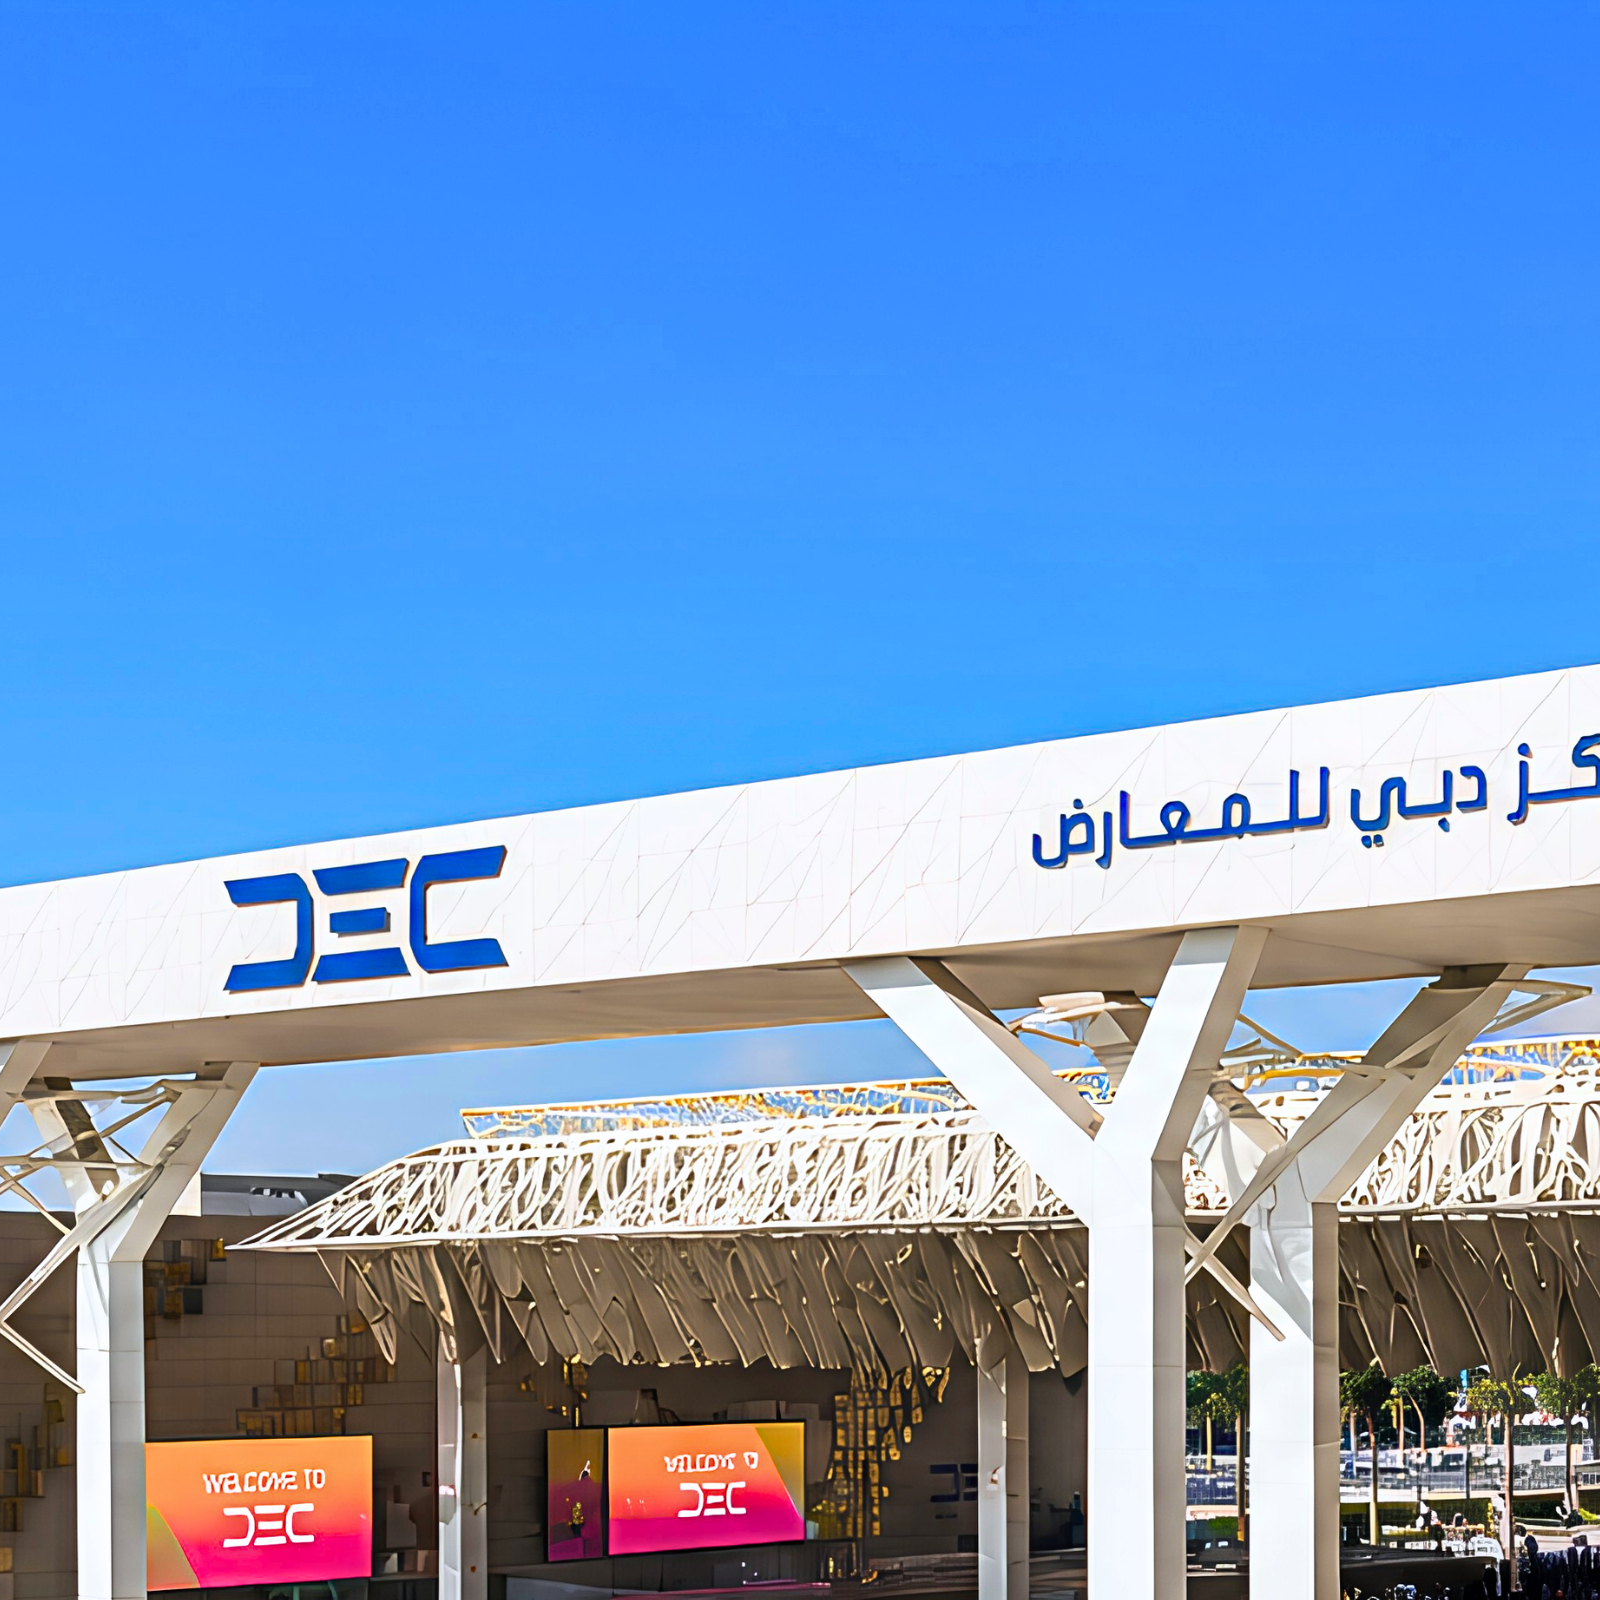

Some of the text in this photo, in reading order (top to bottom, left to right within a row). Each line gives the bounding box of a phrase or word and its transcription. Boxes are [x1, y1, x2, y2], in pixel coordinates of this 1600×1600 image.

[1032, 766, 1330, 870] للمعارض
[1350, 765, 1488, 848] دبي
[223, 844, 508, 995] DEC
